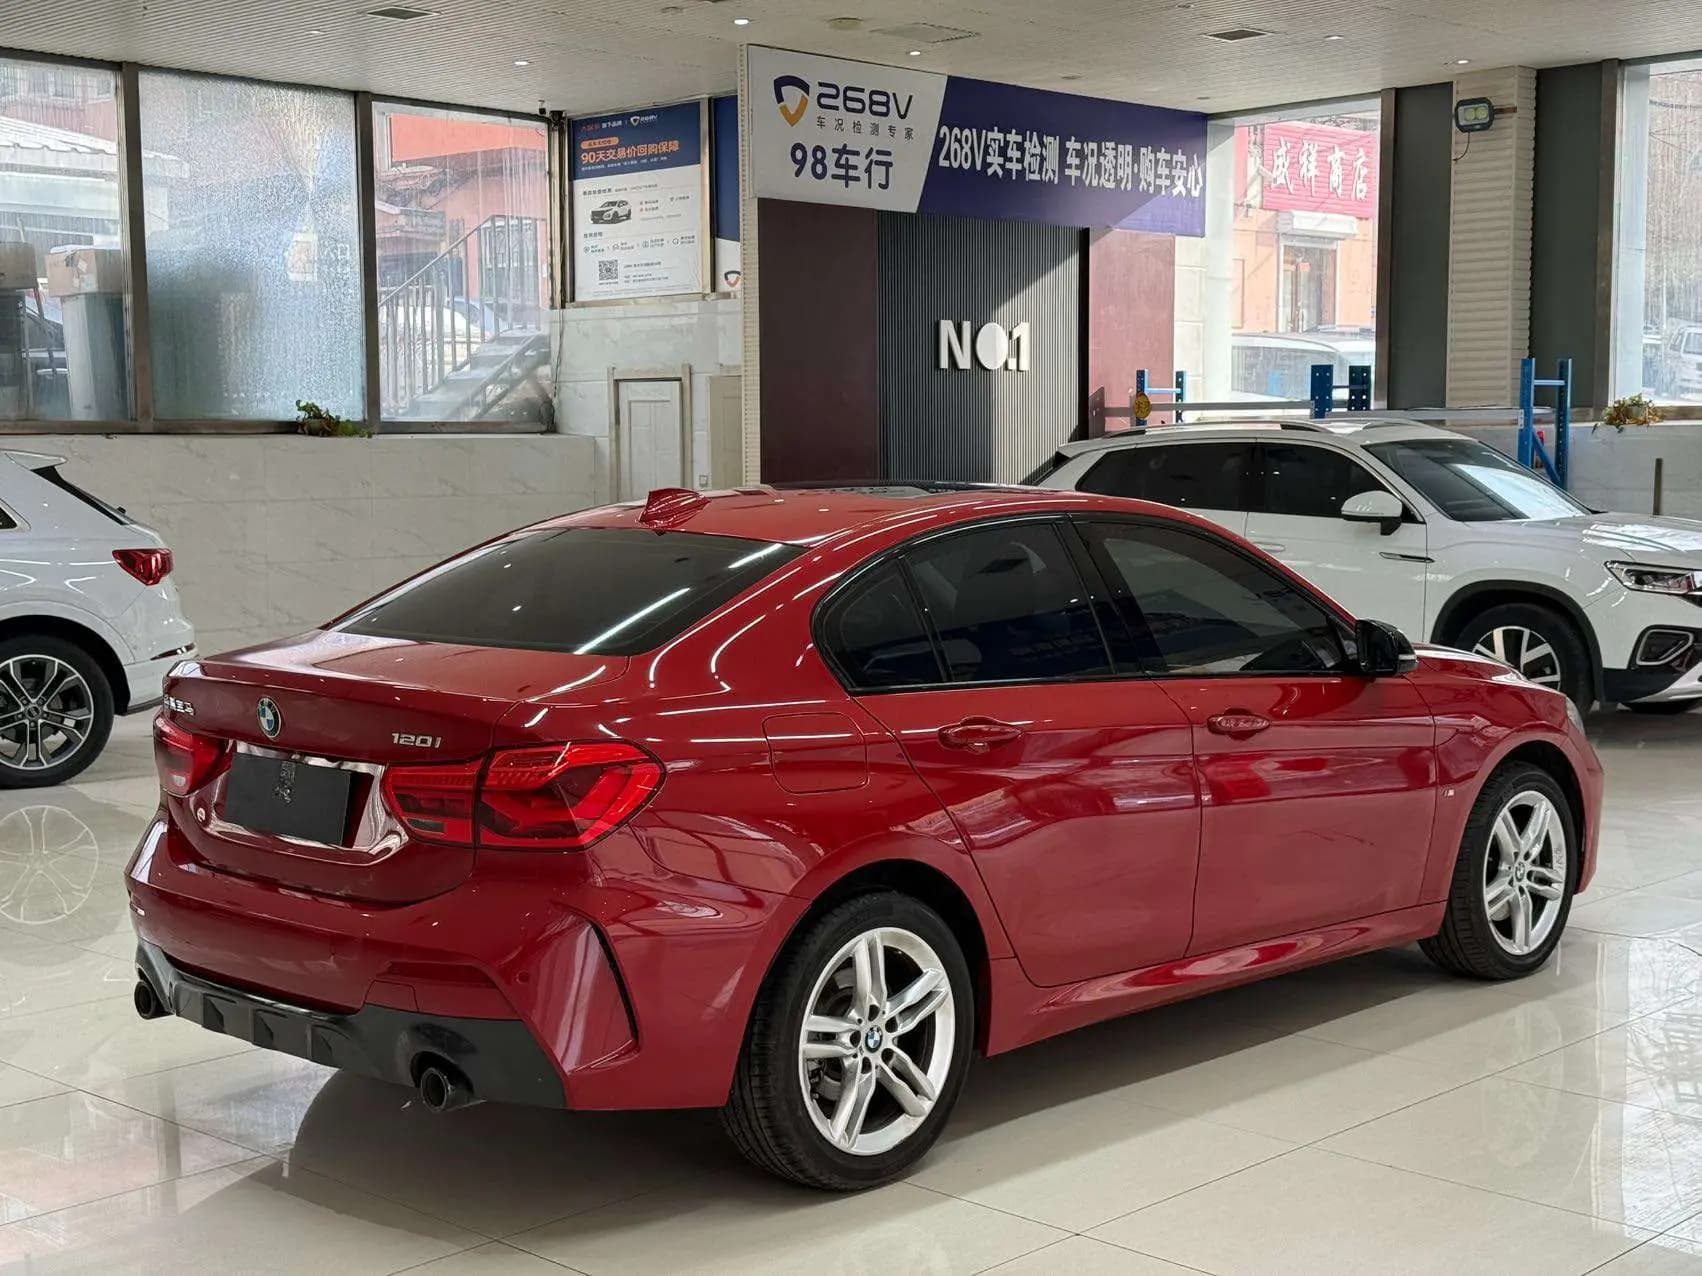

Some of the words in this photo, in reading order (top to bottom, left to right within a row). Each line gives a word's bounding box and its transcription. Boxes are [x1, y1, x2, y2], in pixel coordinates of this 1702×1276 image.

[816, 80, 914, 121] 268V
[816, 115, 914, 142] 车况检测专家
[580, 140, 680, 165] 90天交易价回购保障
[790, 142, 894, 191] 98车行
[938, 125, 1060, 186] 268V实车检测
